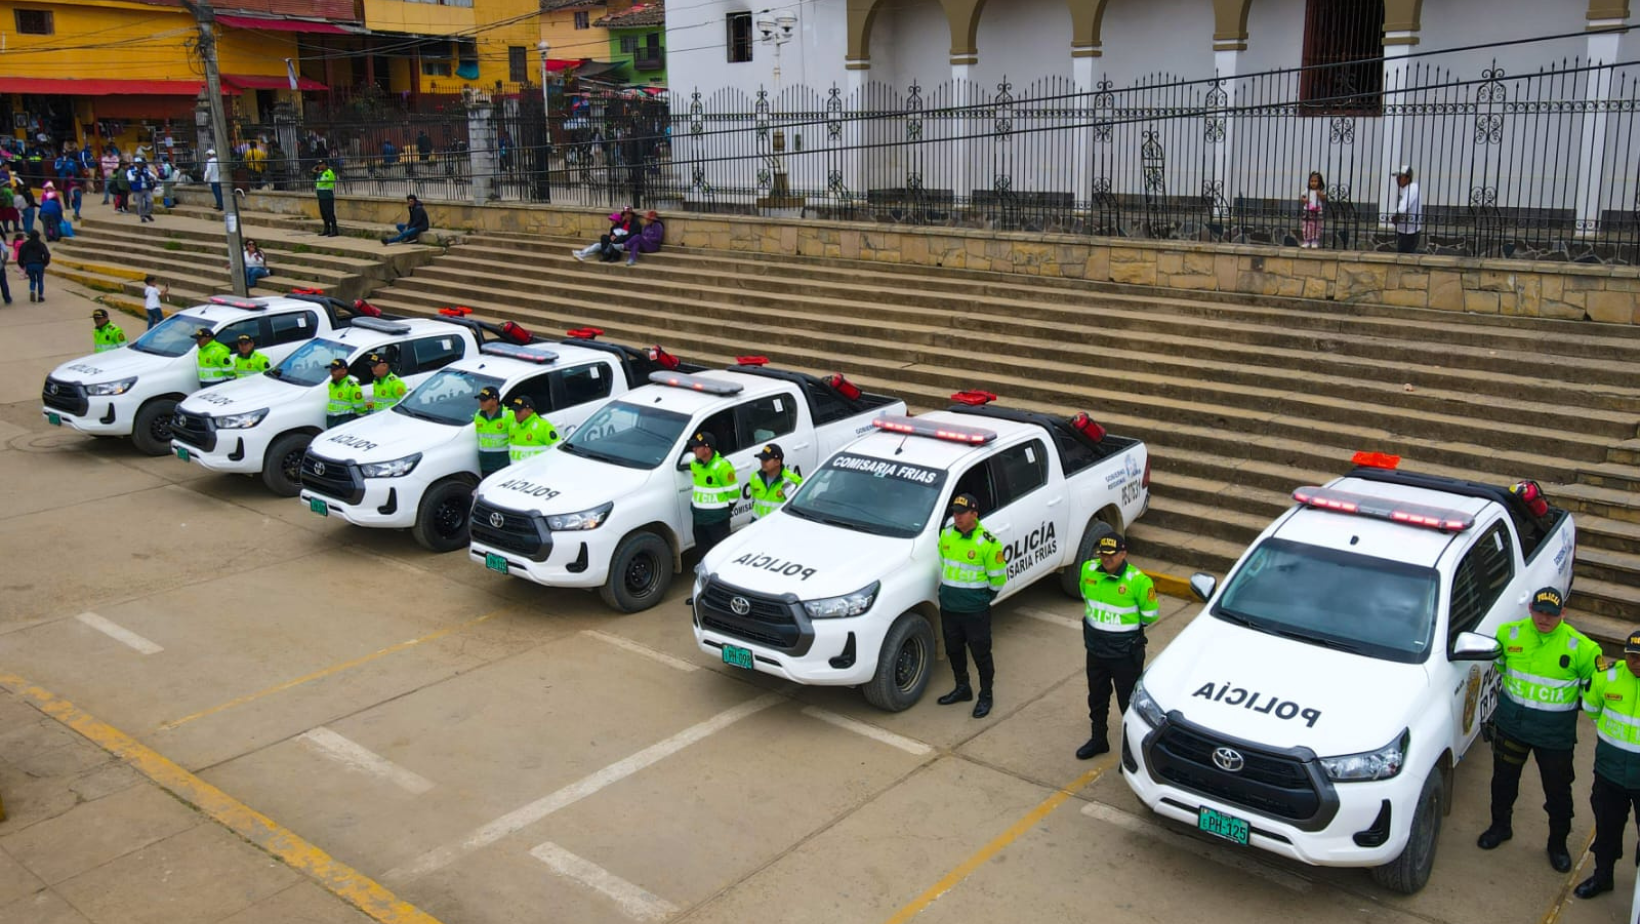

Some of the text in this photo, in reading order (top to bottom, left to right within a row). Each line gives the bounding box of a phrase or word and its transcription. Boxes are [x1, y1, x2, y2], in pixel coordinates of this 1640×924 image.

[832, 456, 937, 484] COMISARIA FRIAS
[1003, 520, 1056, 565] OLICÍA
[1006, 540, 1058, 581] ISARIA FRIAS
